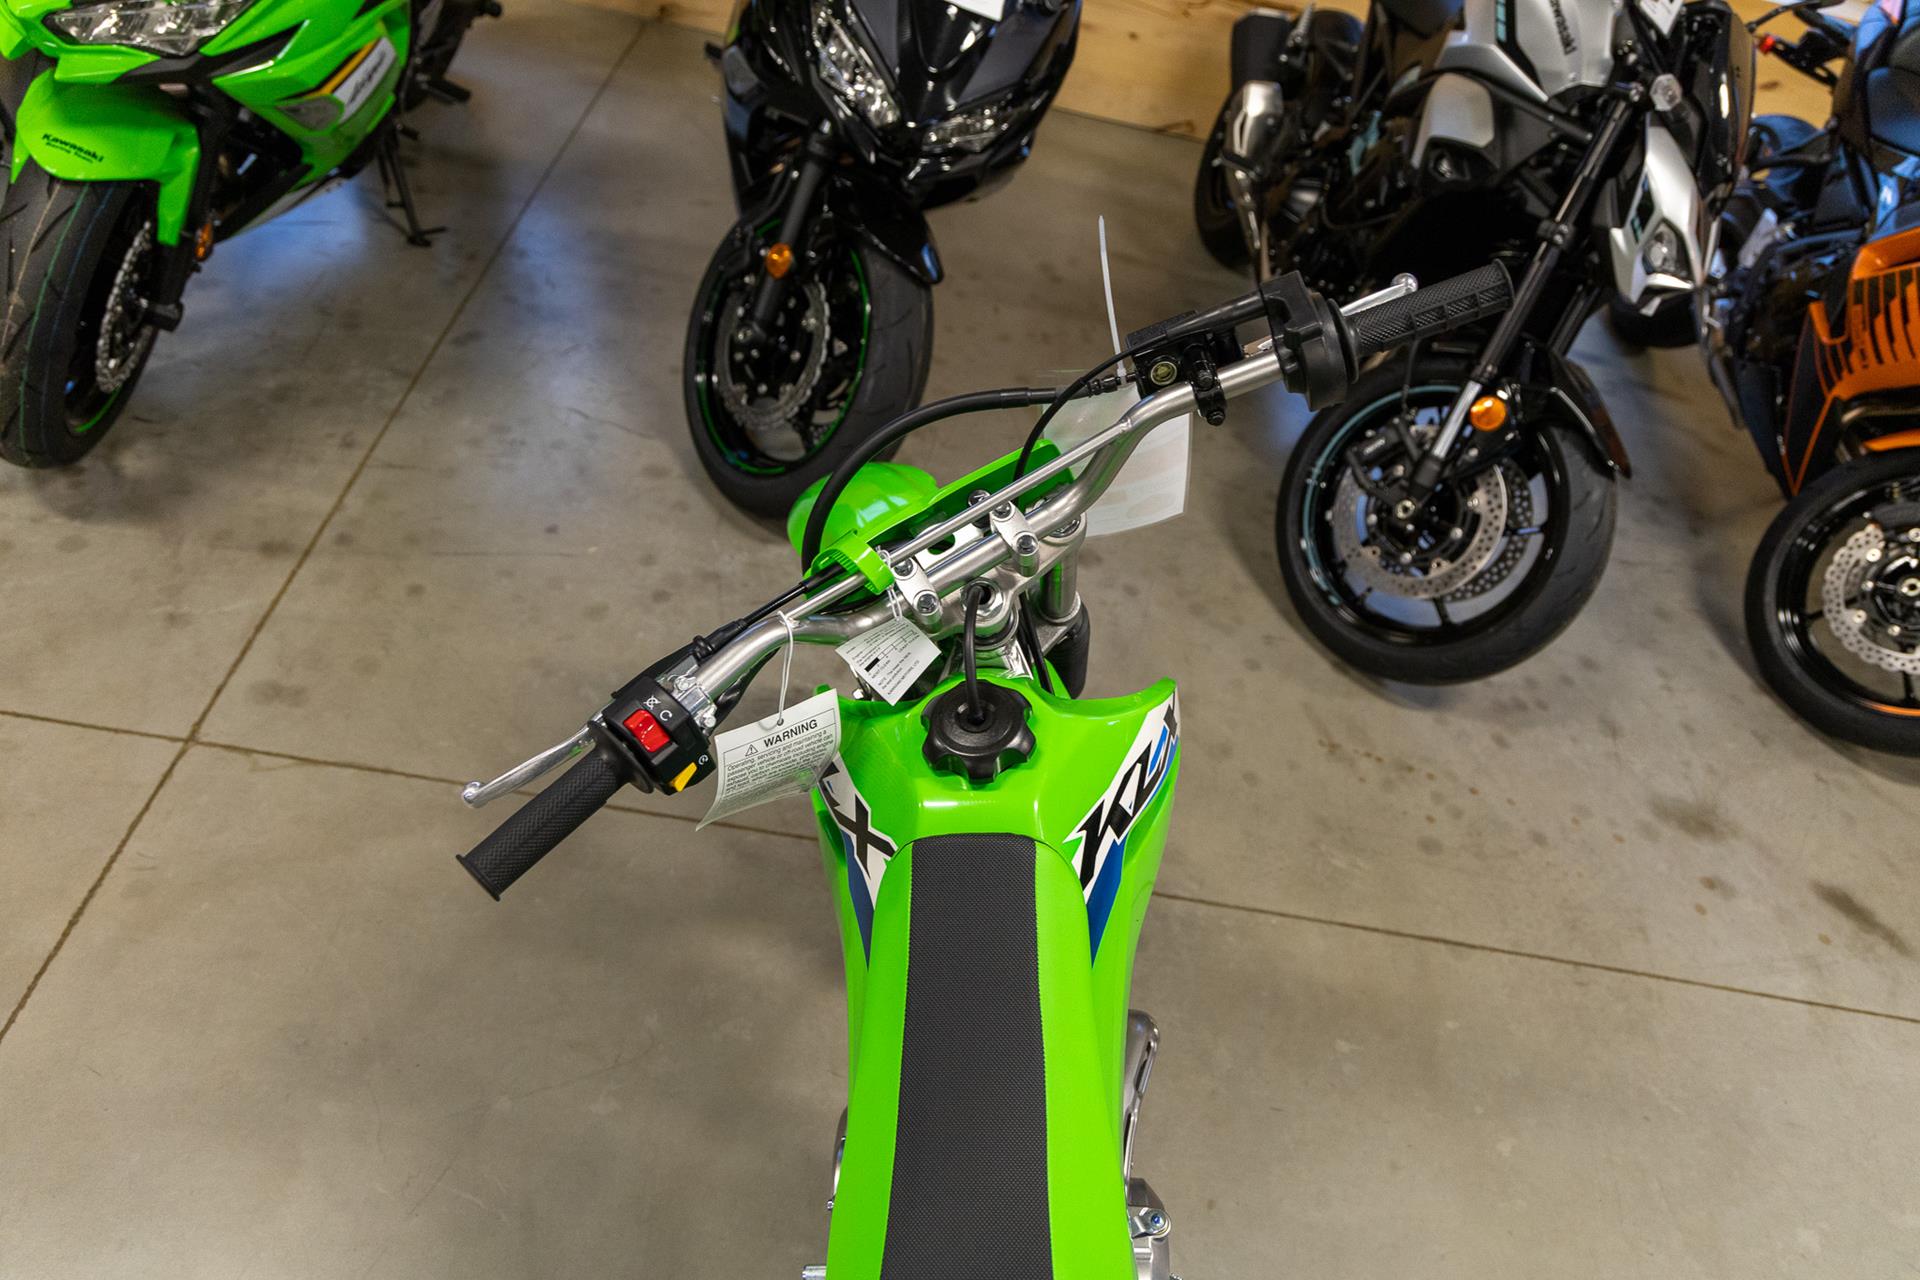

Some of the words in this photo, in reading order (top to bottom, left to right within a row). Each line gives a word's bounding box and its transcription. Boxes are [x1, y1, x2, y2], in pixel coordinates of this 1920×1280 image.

[1549, 0, 1578, 56] awasaki
[42, 133, 104, 163] Kawasaki
[763, 719, 818, 748] WARNING
[818, 760, 896, 881] LX
